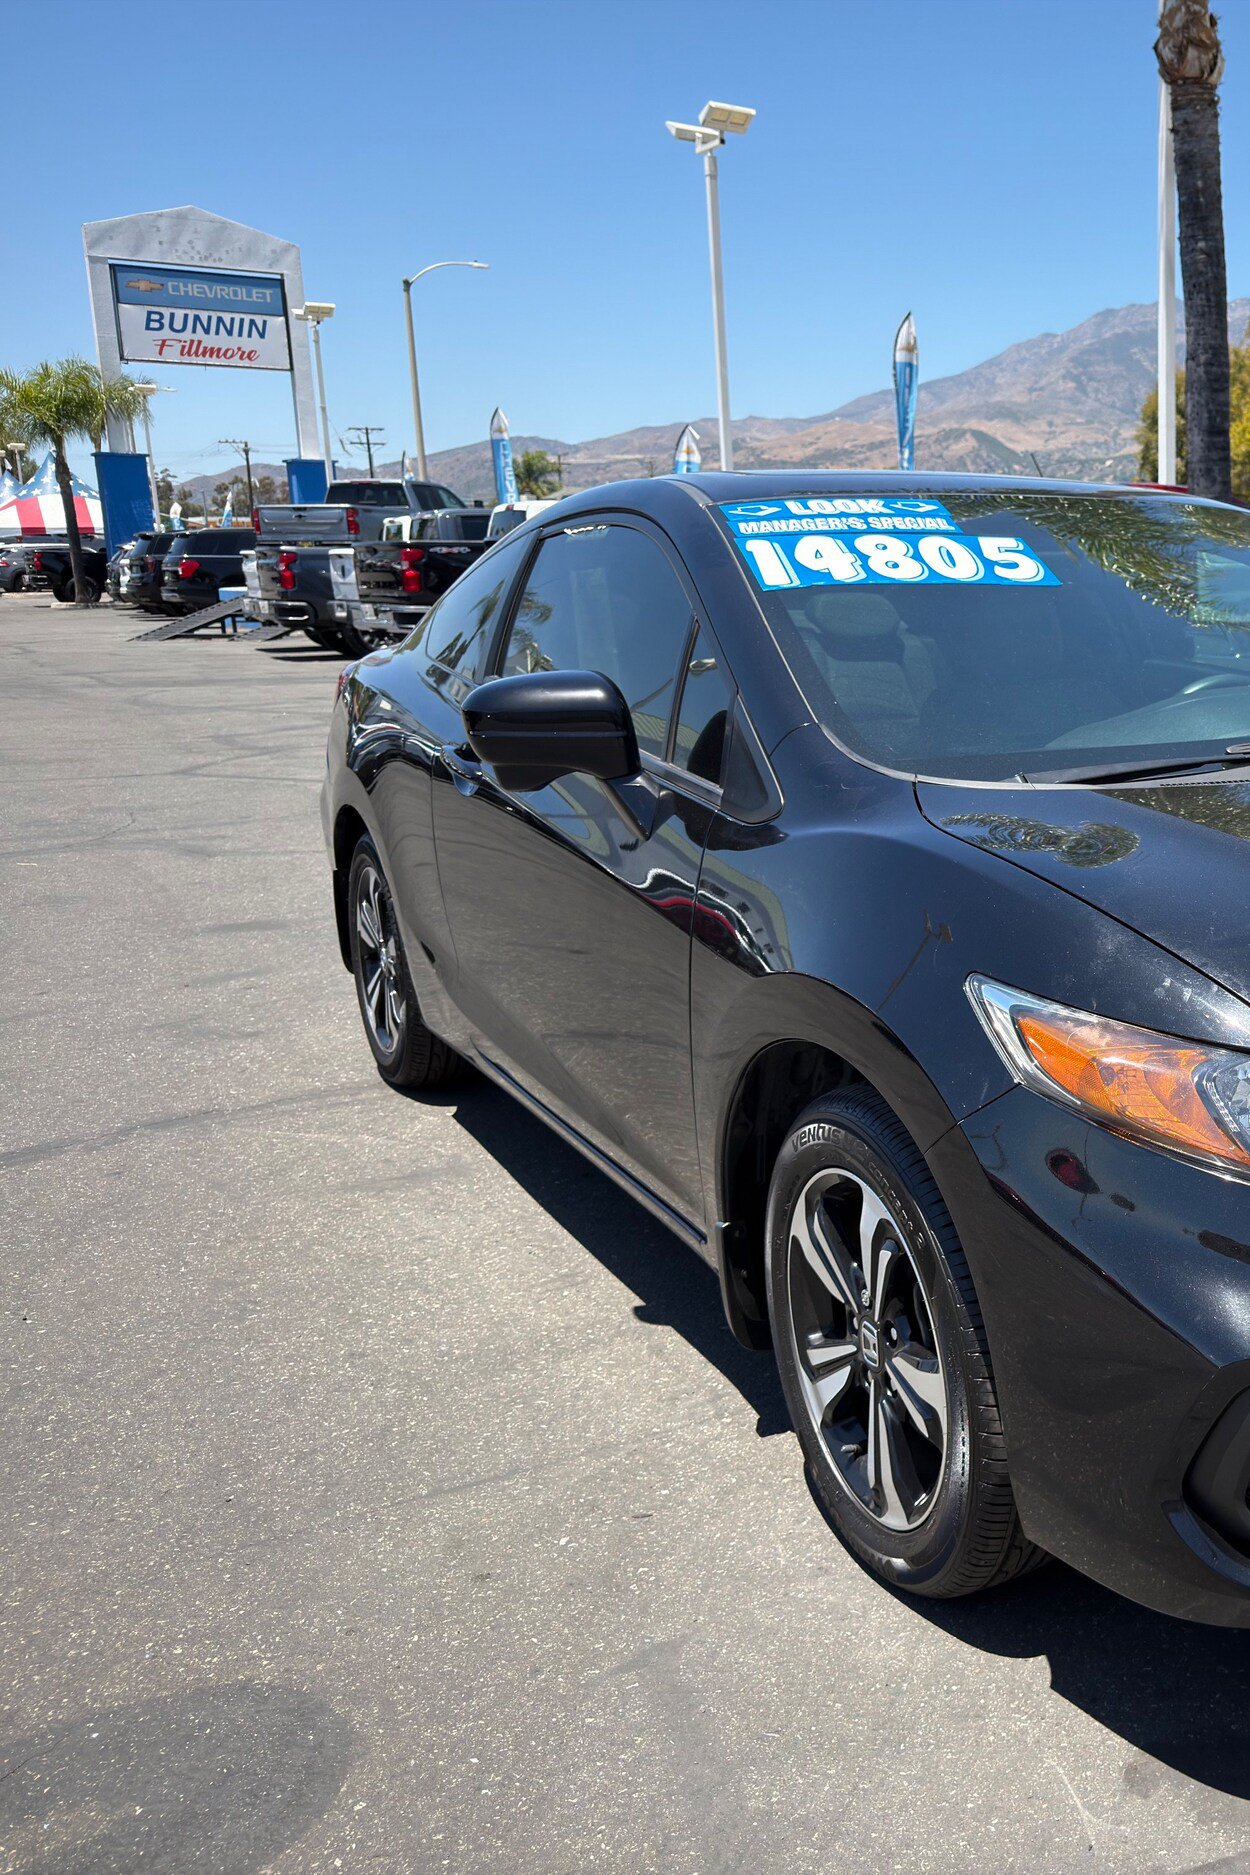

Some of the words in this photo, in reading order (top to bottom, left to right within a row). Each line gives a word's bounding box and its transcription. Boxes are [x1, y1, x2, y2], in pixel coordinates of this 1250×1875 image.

[167, 281, 273, 303] CHEVROLET
[144, 310, 267, 339] BUNNIN
[152, 338, 260, 363] Fillmore
[788, 499, 895, 515] LOOK
[738, 516, 867, 534] MANAGER'S
[869, 516, 956, 531] SPECIAL
[744, 534, 1045, 587] 14805
